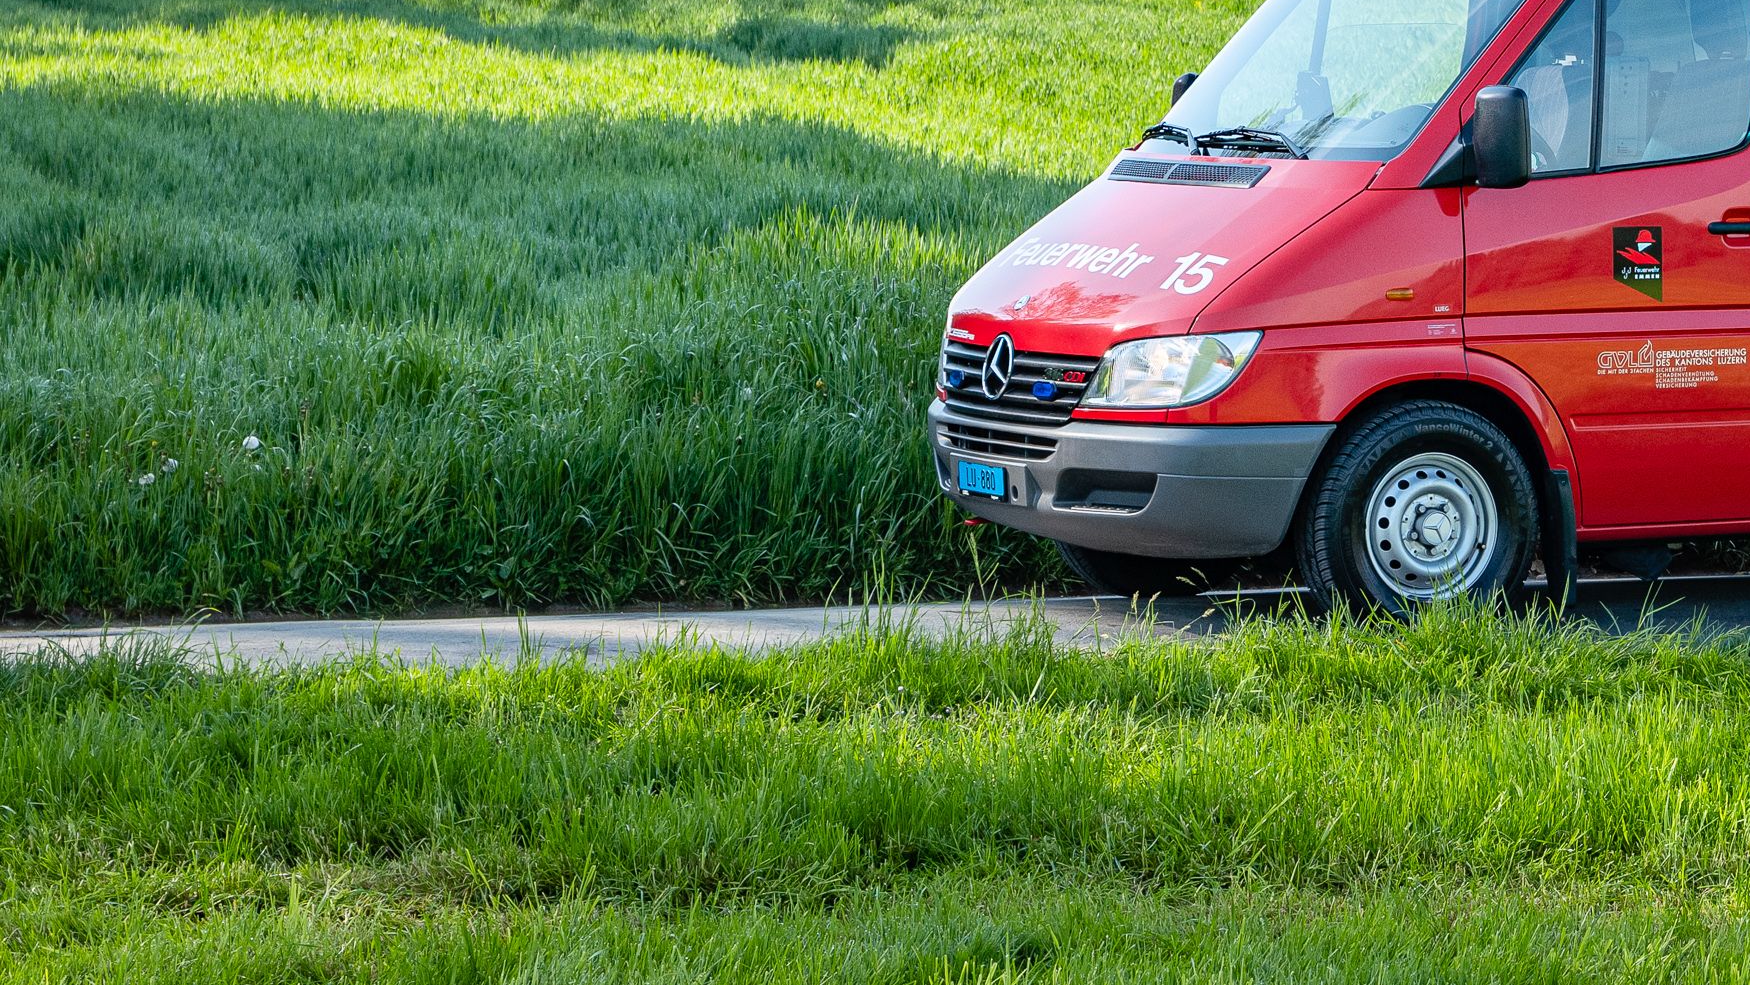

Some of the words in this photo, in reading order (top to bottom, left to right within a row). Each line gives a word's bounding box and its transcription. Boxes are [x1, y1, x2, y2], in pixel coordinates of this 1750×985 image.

[1001, 237, 1154, 279] Feuerwehr
[1159, 251, 1230, 295] 15
[1655, 348, 1747, 359] GEBÄUDEVERSICHERUNG
[1655, 359, 1671, 367] DES
[1675, 357, 1713, 366] KANTONS
[1717, 356, 1747, 365] LUZERN
[1414, 423, 1485, 443] VancoWinter
[1485, 440, 1494, 450] 2
